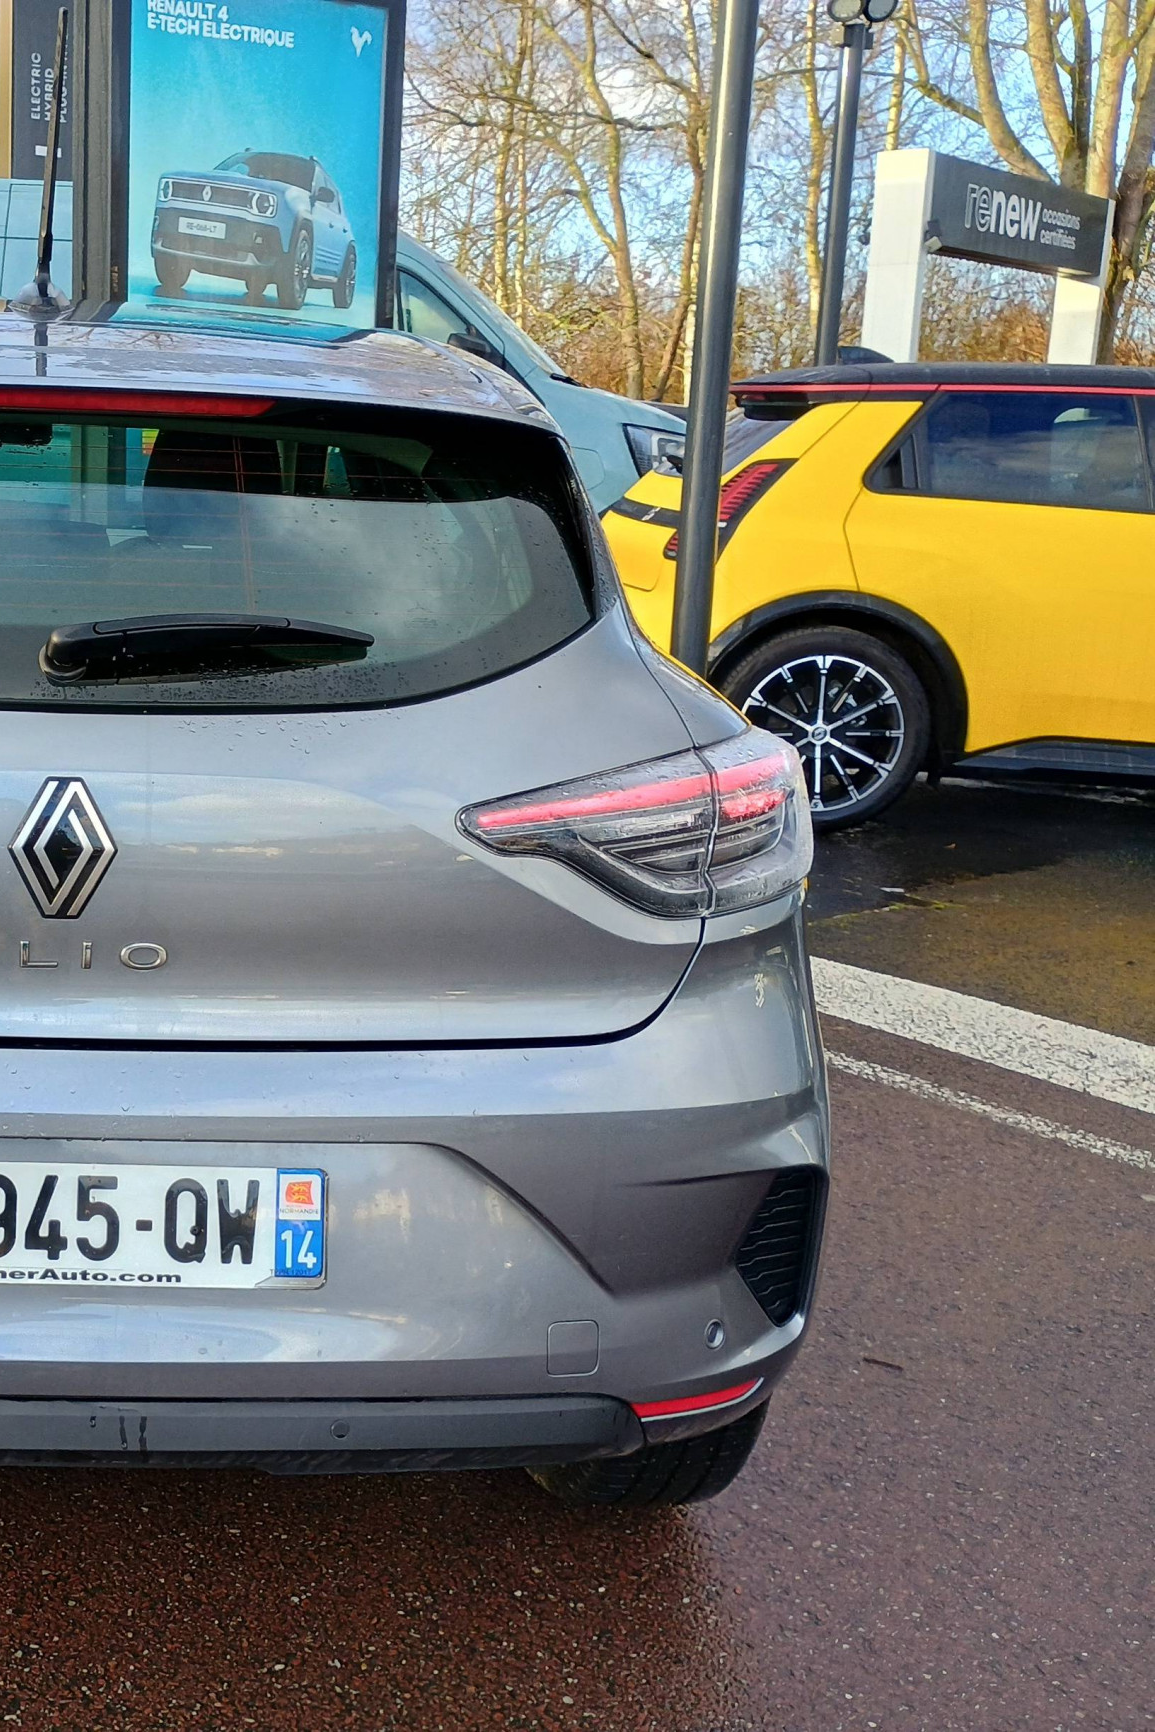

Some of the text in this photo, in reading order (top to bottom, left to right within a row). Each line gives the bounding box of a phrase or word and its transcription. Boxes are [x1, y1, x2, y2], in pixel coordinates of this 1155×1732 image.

[147, 0, 229, 21] RENAULT 4
[147, 12, 200, 36] E-TECH
[31, 52, 41, 120] ELECTRIC
[964, 183, 1042, 241] renew
[280, 1229, 318, 1269] 14
